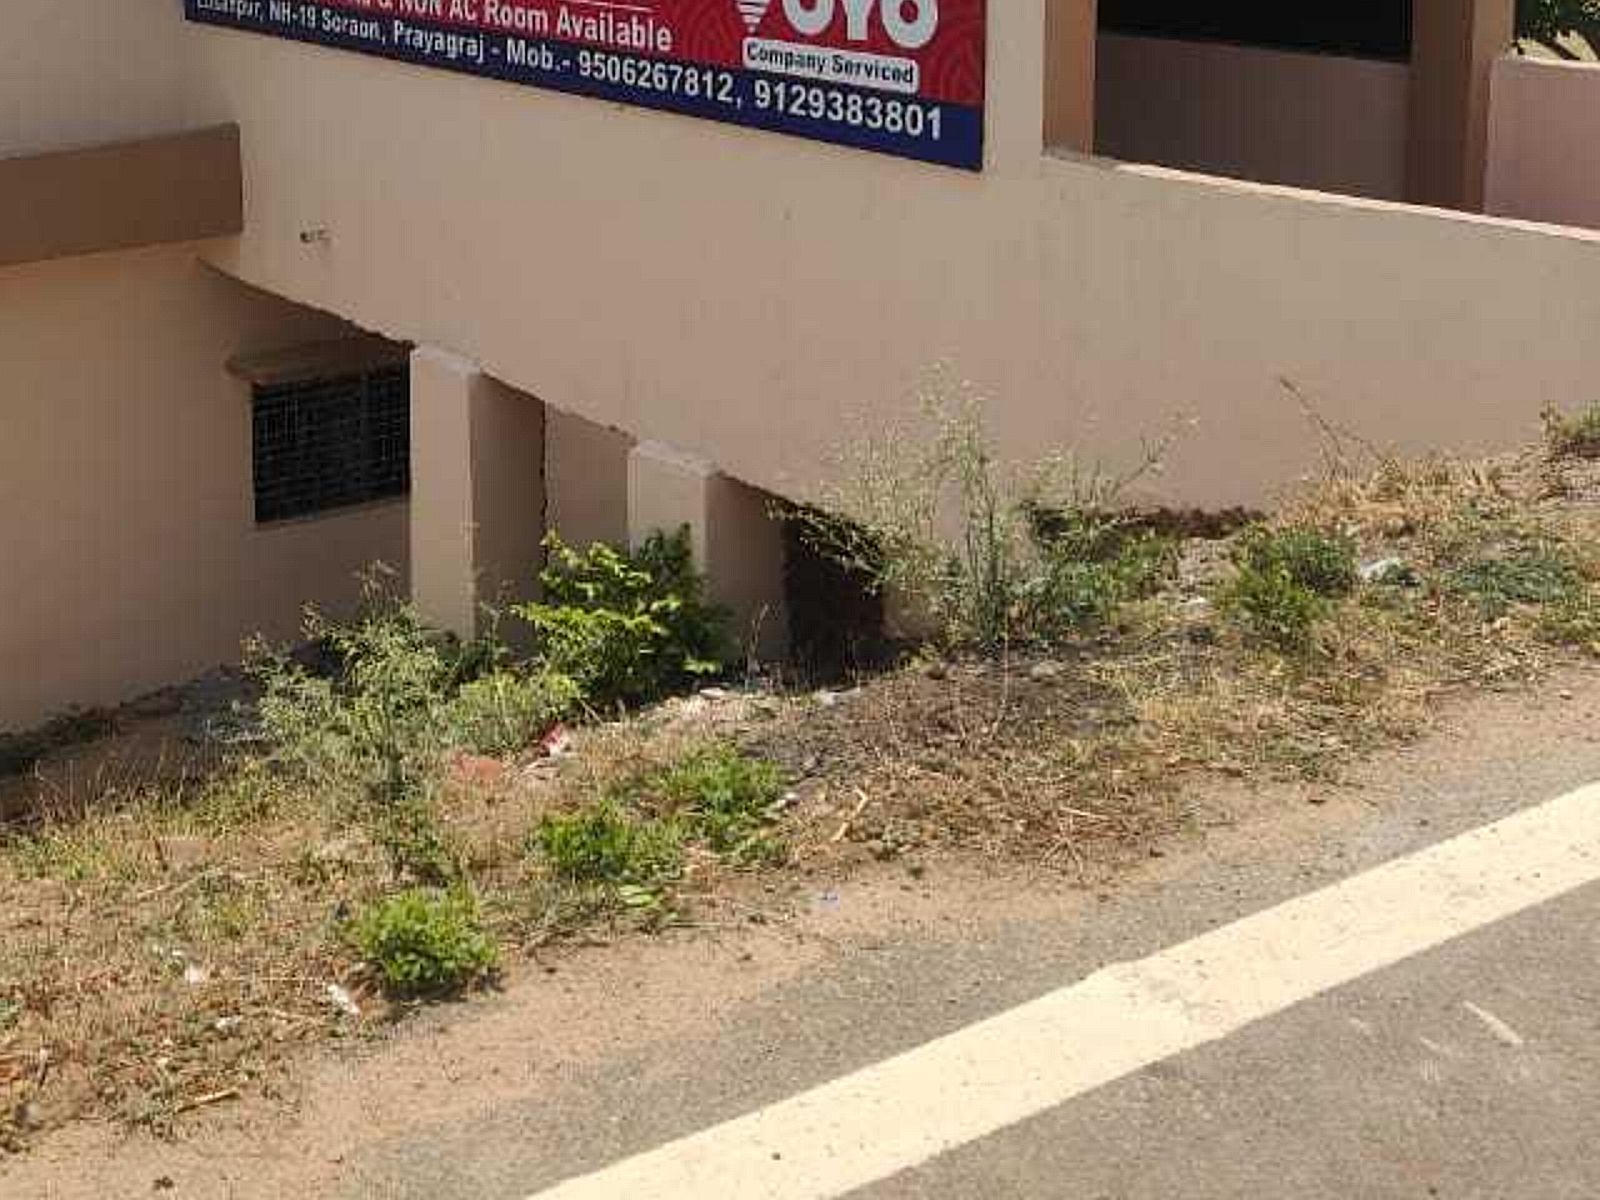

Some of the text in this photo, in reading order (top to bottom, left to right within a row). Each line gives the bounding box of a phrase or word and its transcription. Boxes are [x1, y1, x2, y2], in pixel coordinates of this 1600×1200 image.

[556, 5, 673, 52] Available
[269, 0, 317, 29] NH-19
[394, 19, 484, 64] Prayagraj
[578, 50, 742, 110] 9506267812,
[754, 79, 941, 141] 9129383801
[747, 42, 915, 84] Company Serviced
